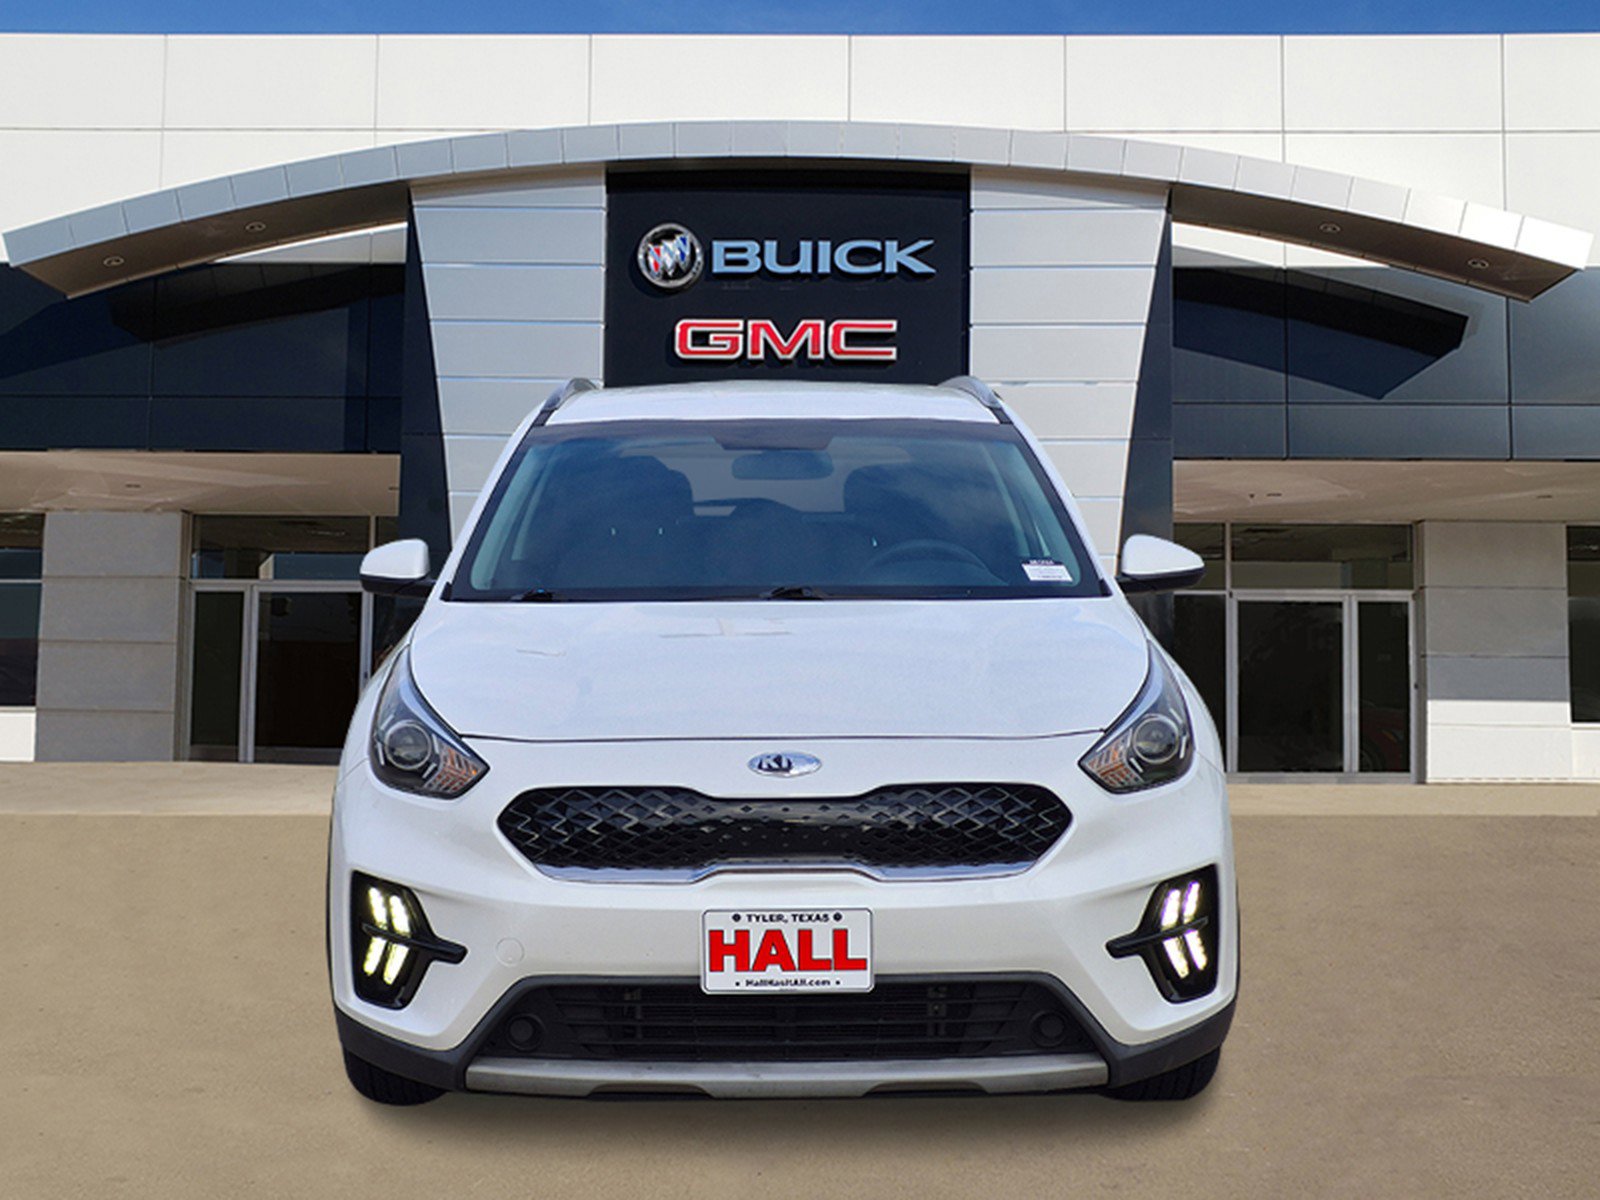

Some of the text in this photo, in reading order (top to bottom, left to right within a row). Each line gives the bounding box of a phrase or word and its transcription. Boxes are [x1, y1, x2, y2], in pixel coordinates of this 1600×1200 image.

[711, 239, 937, 274] BUICK
[674, 319, 898, 361] GMC
[746, 913, 829, 924] TYLER, TEXAS
[708, 928, 867, 972] HALL
